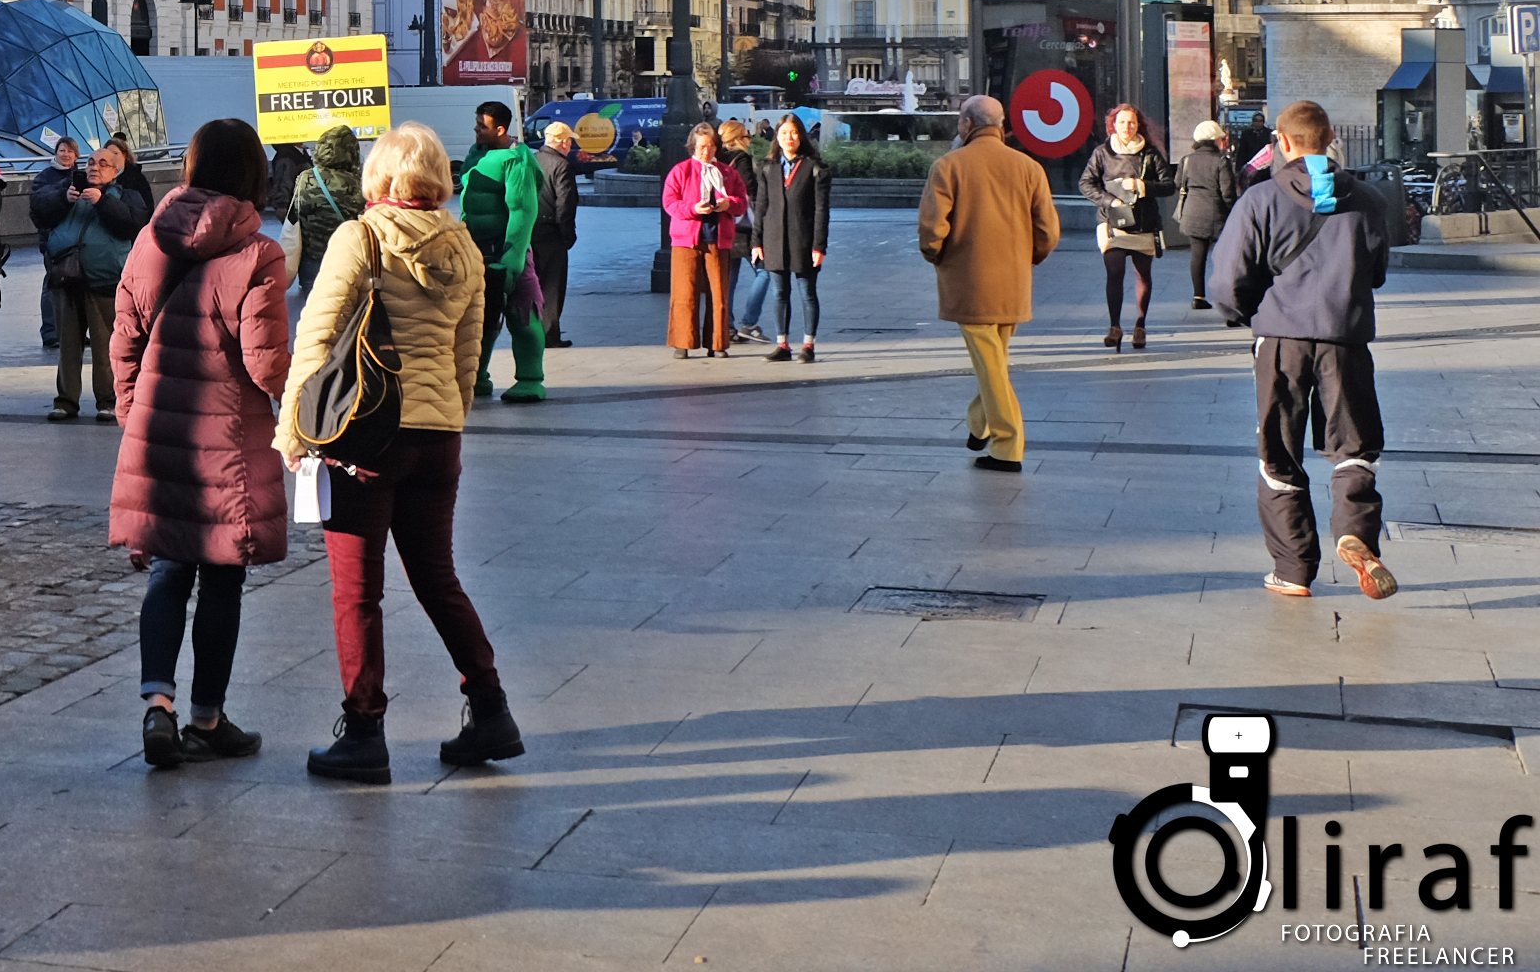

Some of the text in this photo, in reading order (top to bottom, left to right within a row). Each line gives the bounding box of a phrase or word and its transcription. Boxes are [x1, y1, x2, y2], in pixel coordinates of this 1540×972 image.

[1520, 11, 1536, 52] P
[277, 80, 310, 89] MEETING
[311, 79, 333, 88] POINT
[334, 77, 350, 86] FOR
[270, 88, 375, 111] FREE TOUR
[283, 114, 295, 122] ALL
[331, 110, 371, 119] ACTIVITIES
[647, 118, 663, 127] Se
